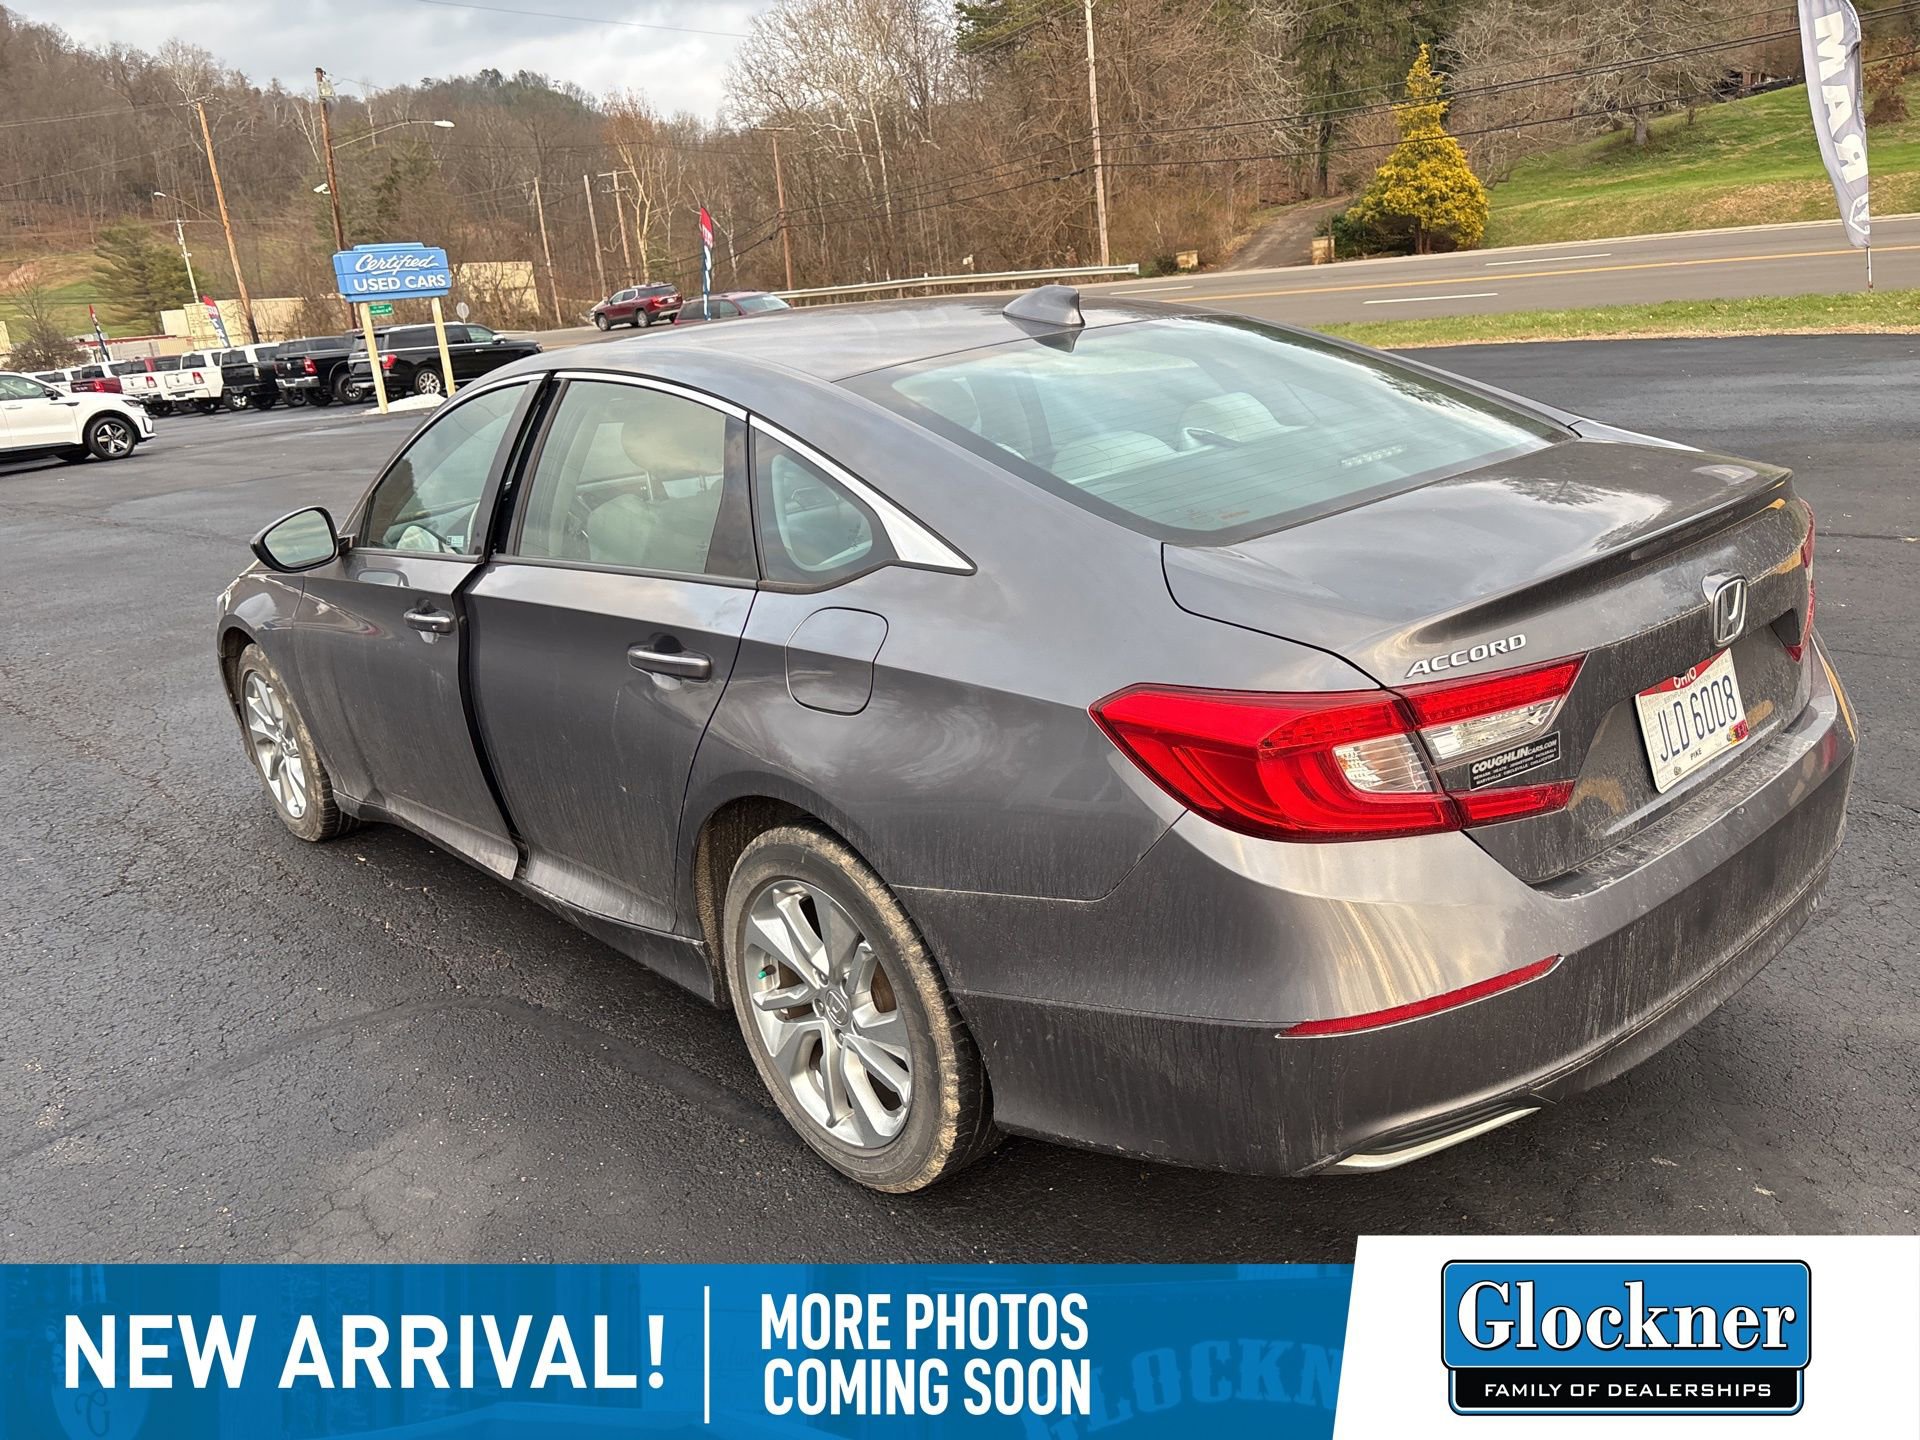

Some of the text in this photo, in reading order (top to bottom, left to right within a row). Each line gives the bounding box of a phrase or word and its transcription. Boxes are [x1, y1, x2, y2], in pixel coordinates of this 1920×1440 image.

[355, 253, 439, 275] Certified
[353, 274, 446, 292] USED CARS
[1405, 634, 1527, 679] ACCORD
[1658, 700, 1690, 762] JLD
[1690, 675, 1738, 739] 6008
